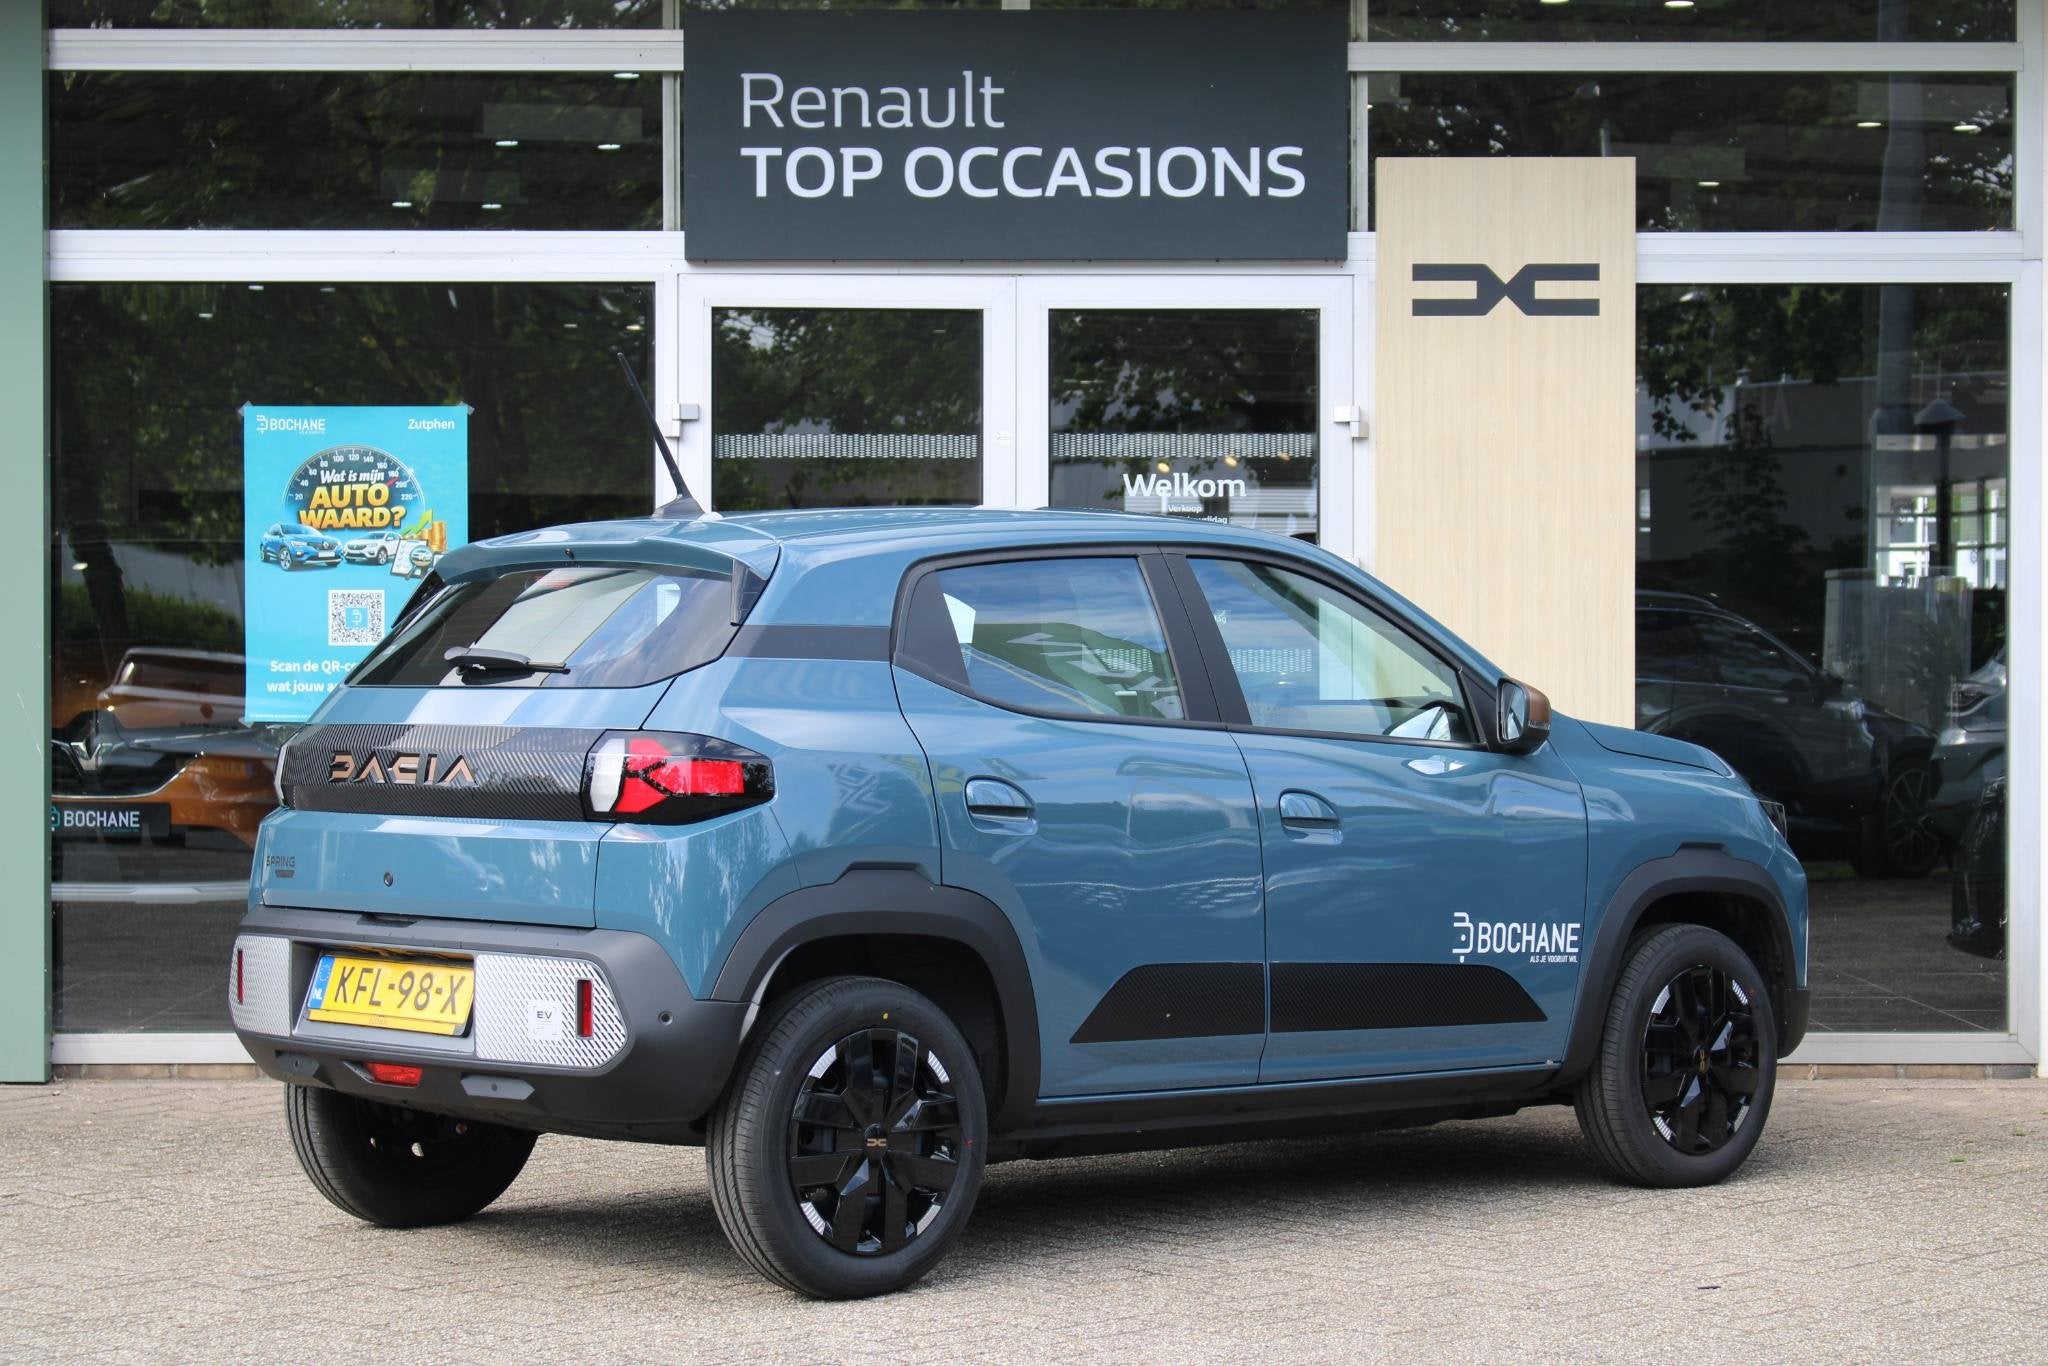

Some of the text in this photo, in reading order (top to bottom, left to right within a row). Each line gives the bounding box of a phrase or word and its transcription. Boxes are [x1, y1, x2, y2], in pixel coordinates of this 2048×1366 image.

[741, 70, 1005, 129] Renault
[740, 146, 1307, 198] TOP OCCASIONS
[270, 418, 326, 431] BOCHANE
[407, 418, 455, 431] Zutphen
[333, 455, 344, 463] 100
[320, 469, 385, 485] Wat is mijn
[1122, 472, 1247, 498] Welkom
[309, 483, 389, 509] AUTO
[1168, 504, 1202, 514] Verkoop
[299, 506, 406, 529] WAARD?
[270, 660, 300, 673] Scan
[303, 660, 319, 672] de
[266, 681, 292, 693] wat
[292, 680, 325, 695] jouw
[328, 750, 480, 787] DACIA
[63, 810, 141, 828] BOCHANE
[266, 855, 296, 868] SPRING
[1477, 922, 1581, 953] BOCHANE
[1530, 955, 1540, 963] ALS
[1540, 955, 1547, 963] JE
[312, 987, 323, 1000] NL
[334, 965, 466, 1015] KFL-98-X
[536, 1010, 552, 1019] EV
